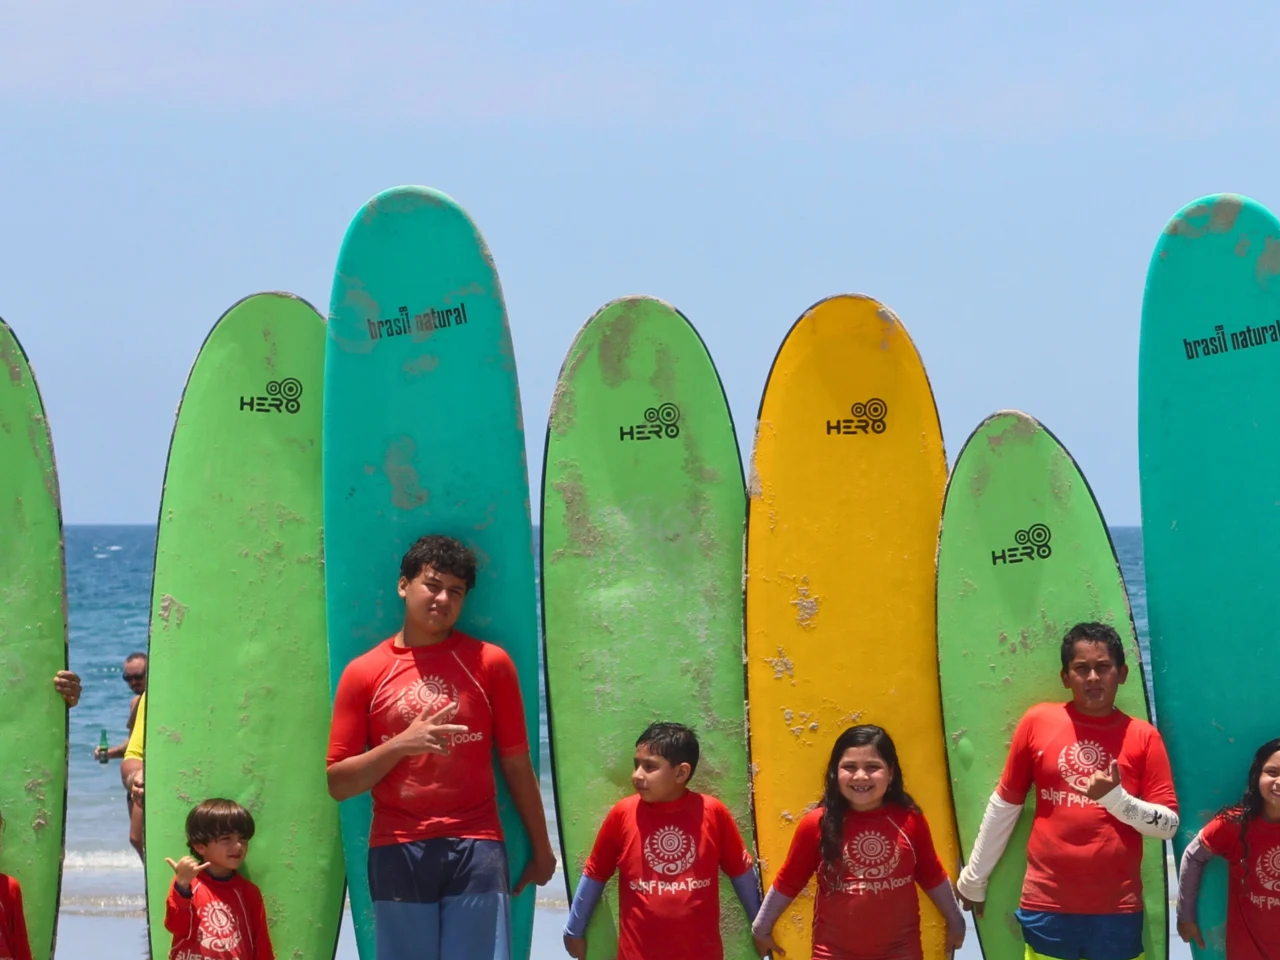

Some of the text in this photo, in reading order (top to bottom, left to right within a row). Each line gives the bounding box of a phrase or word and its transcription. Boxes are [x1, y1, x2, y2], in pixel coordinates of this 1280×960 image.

[367, 303, 468, 340] brasil natural
[1183, 324, 1228, 361] brasil
[239, 396, 301, 414] HERO
[619, 423, 680, 441] HERO
[826, 418, 887, 435] HERO
[991, 544, 1052, 566] HERO
[1040, 787, 1067, 806] SURF
[629, 878, 656, 895] SURF
[658, 880, 687, 896] PARA
